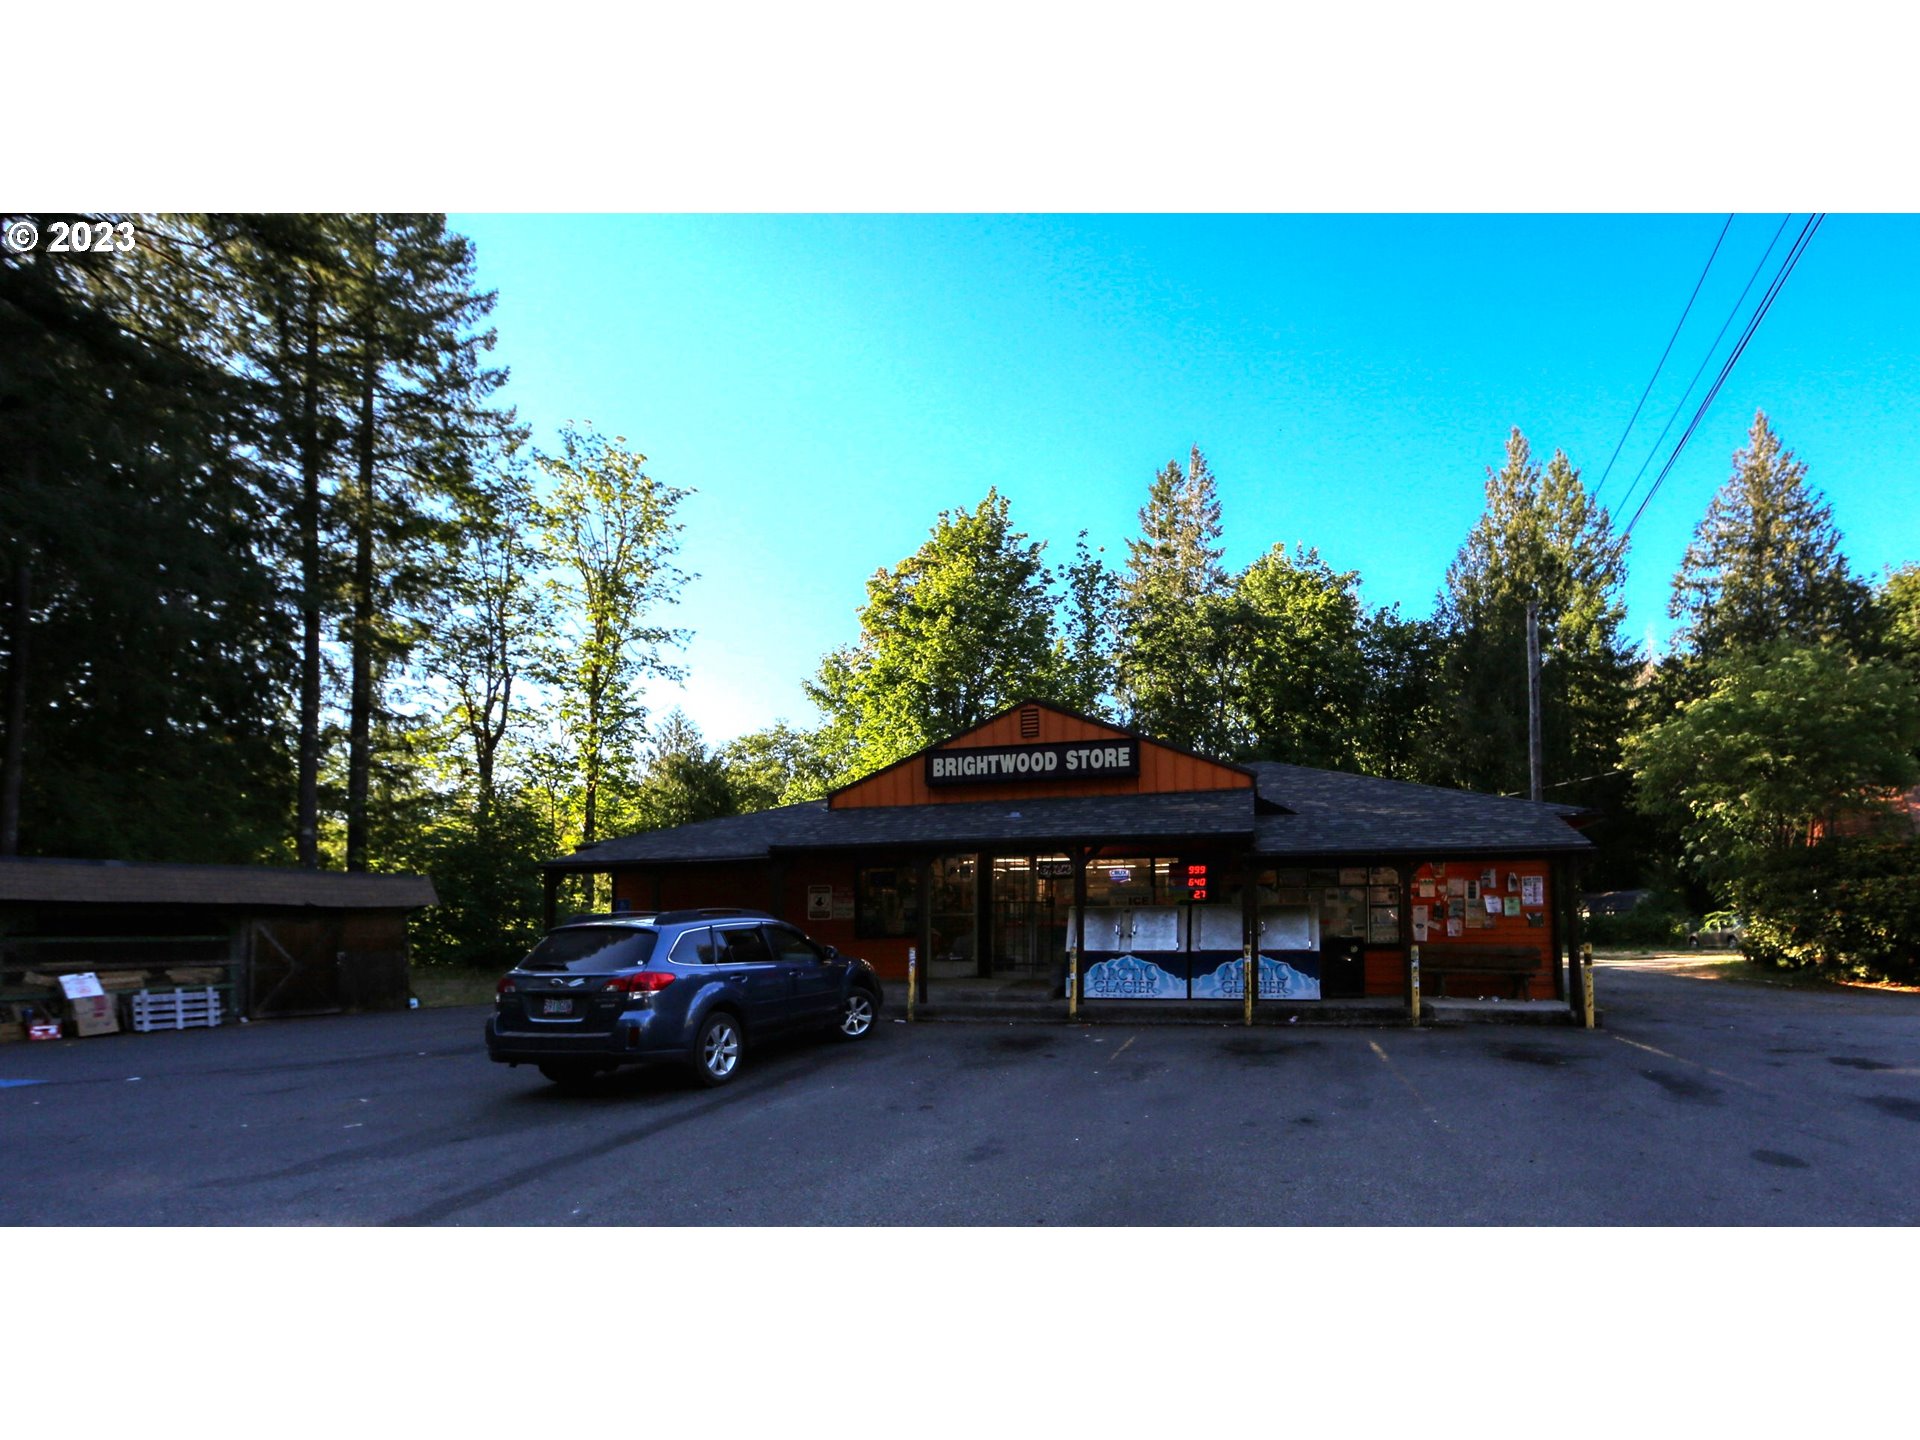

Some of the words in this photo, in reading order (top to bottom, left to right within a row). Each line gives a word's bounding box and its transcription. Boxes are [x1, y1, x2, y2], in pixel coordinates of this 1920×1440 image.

[932, 751, 1058, 777] BRIGHTWOOD
[1066, 747, 1130, 770] STORE
[1188, 865, 1206, 874] 999
[1188, 878, 1206, 887] 640
[1193, 890, 1206, 899] 27
[1128, 896, 1149, 905] ICE
[1094, 964, 1158, 981] ARCTIC
[1221, 964, 1289, 981] ARTIC
[1094, 980, 1157, 993] GLACIER
